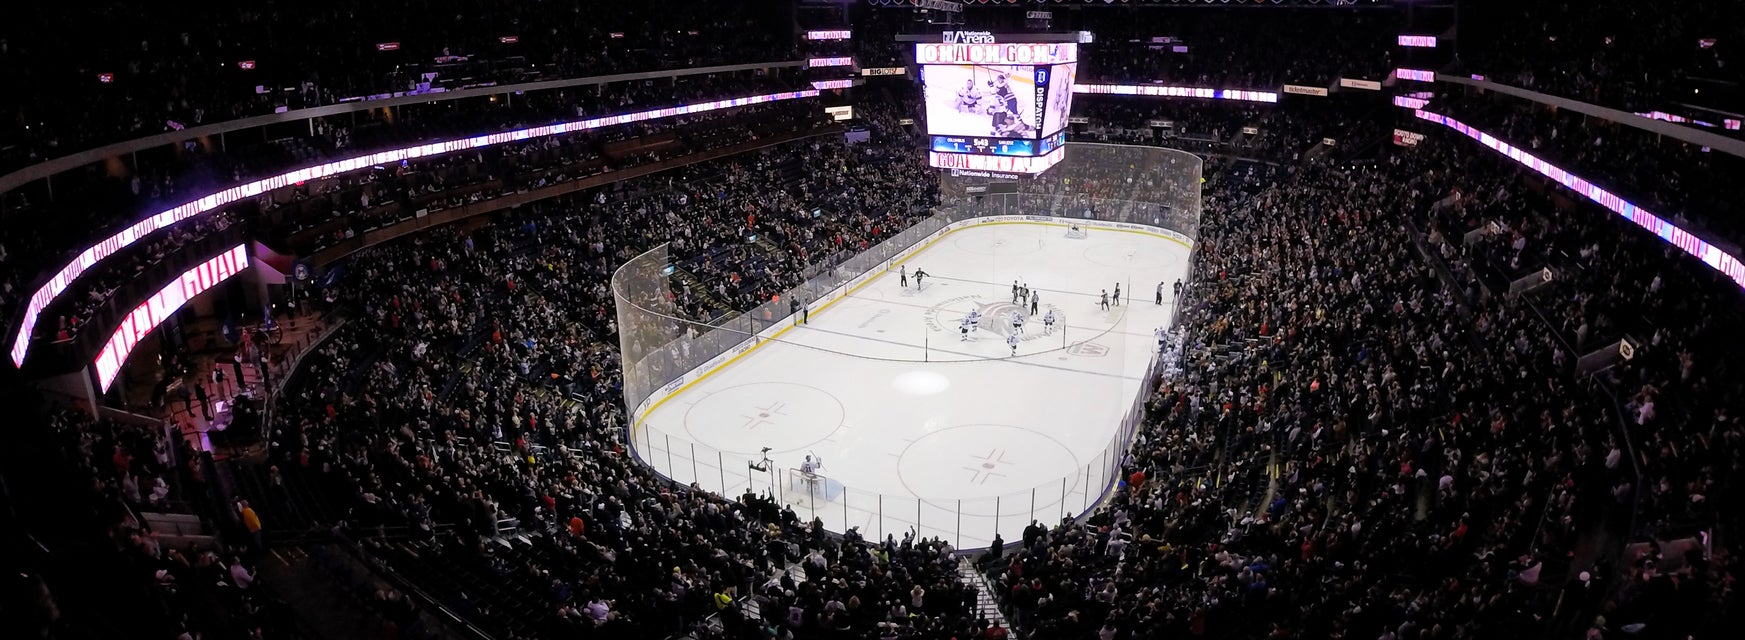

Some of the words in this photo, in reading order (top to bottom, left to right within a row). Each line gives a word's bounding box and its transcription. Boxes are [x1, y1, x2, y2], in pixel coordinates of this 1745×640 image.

[953, 31, 995, 44] Arena
[1288, 86, 1321, 95] ticketmaster
[1035, 87, 1045, 130] DISPATCH
[959, 170, 990, 178] Nationwide
[991, 172, 1019, 180] Insurance
